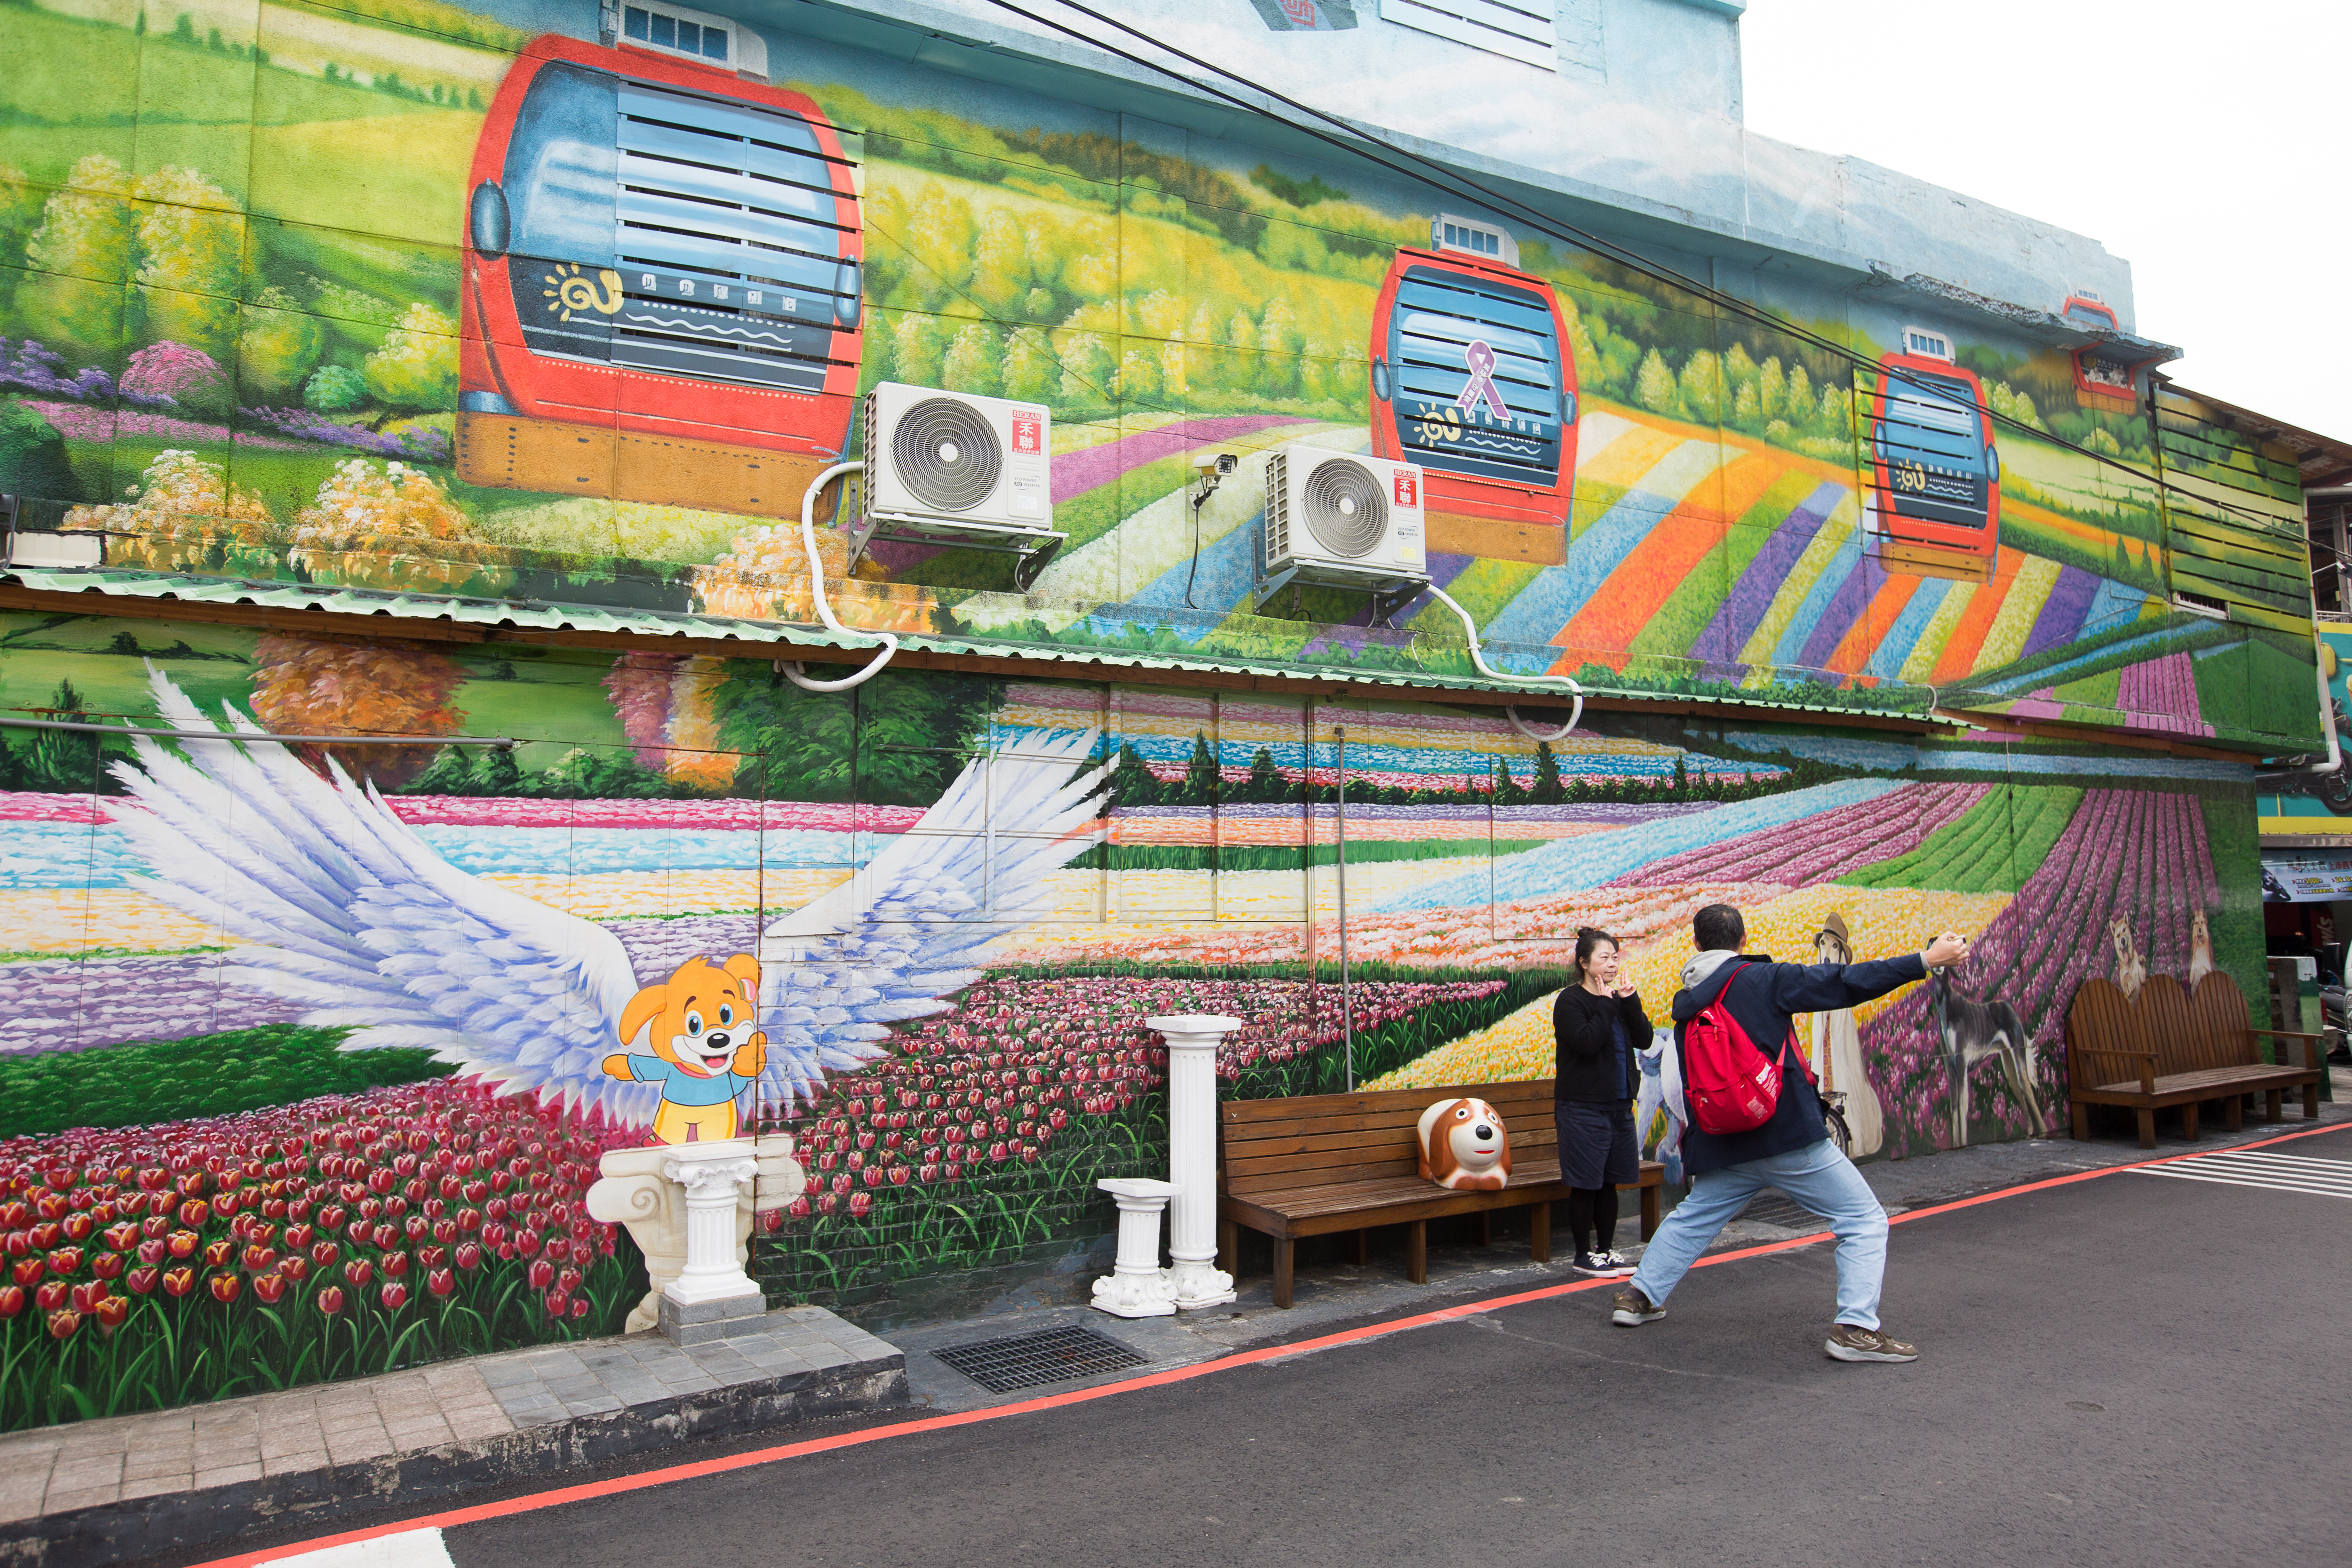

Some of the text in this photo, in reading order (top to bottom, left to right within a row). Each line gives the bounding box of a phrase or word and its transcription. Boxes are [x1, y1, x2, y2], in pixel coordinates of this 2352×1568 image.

[1013, 410, 1041, 420] HERAN
[1019, 422, 1034, 450] 禾聯
[1399, 479, 1411, 504] 禾聯
[2317, 916, 2334, 946] SYM
[1864, 1334, 1877, 1343] FILA
